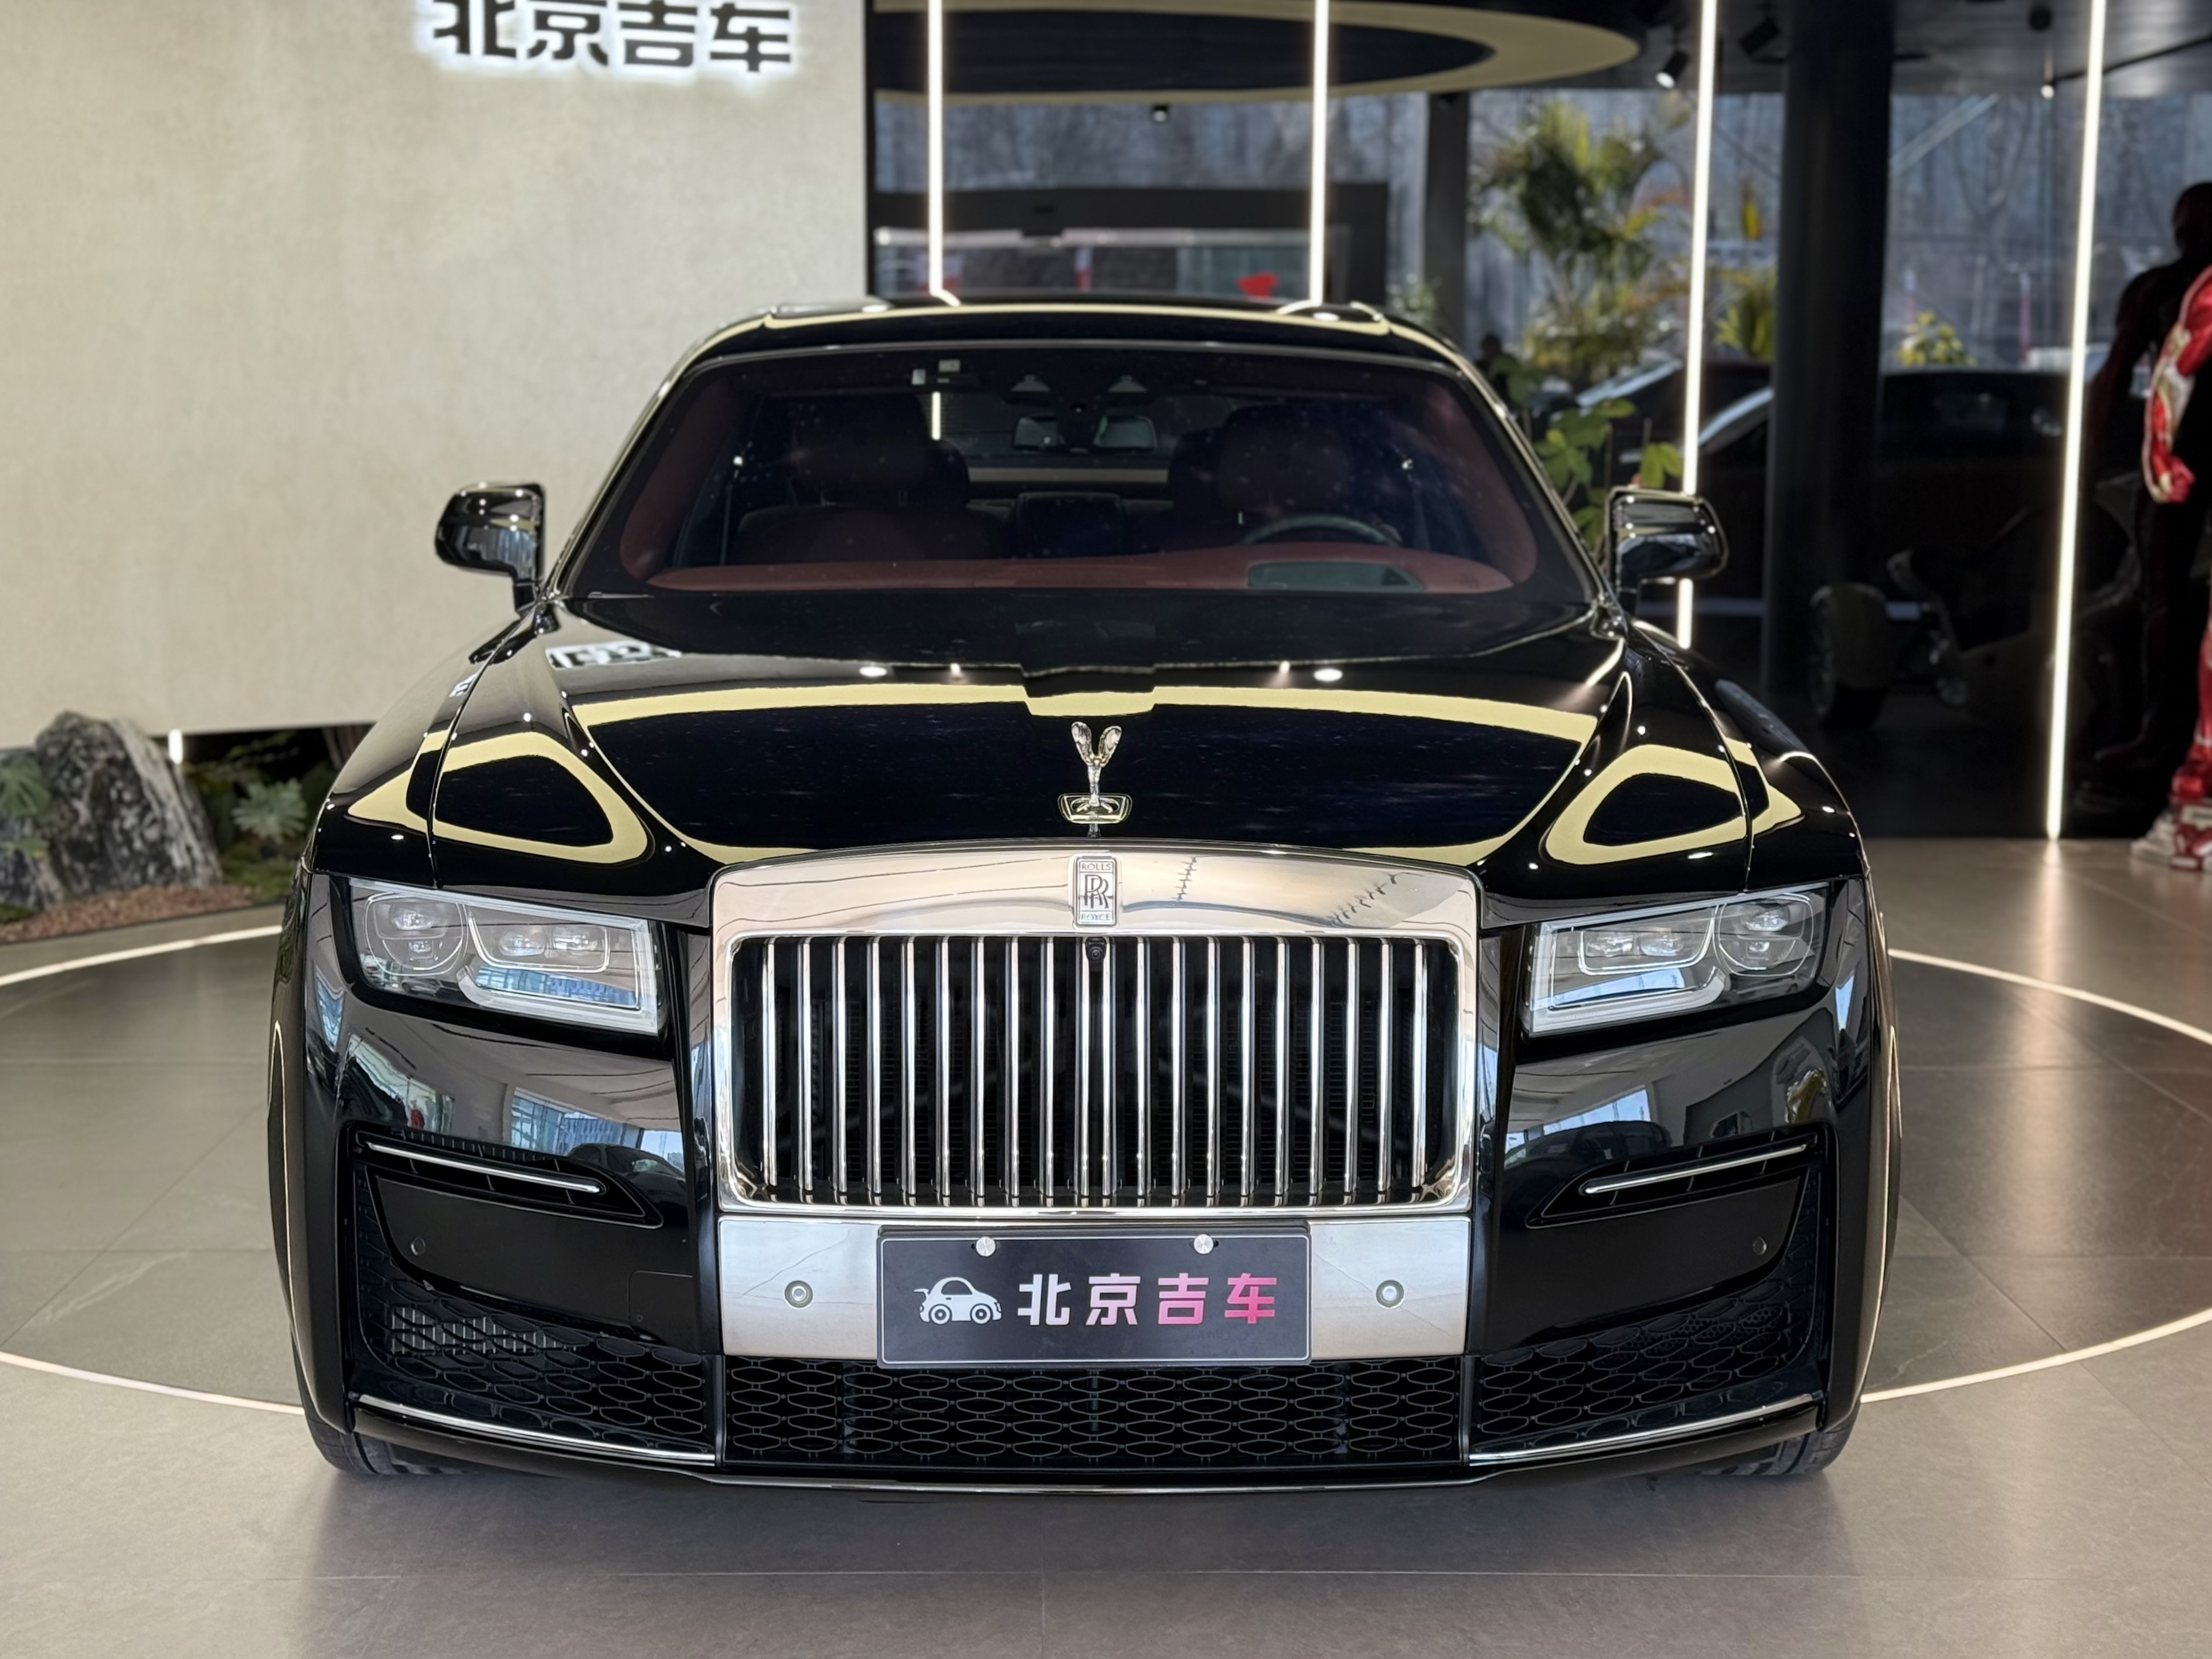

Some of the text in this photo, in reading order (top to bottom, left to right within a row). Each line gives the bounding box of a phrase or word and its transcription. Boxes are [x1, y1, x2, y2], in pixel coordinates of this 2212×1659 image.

[433, 0, 791, 72] 北京吉车
[1017, 1273, 1277, 1326] 北京吉车
